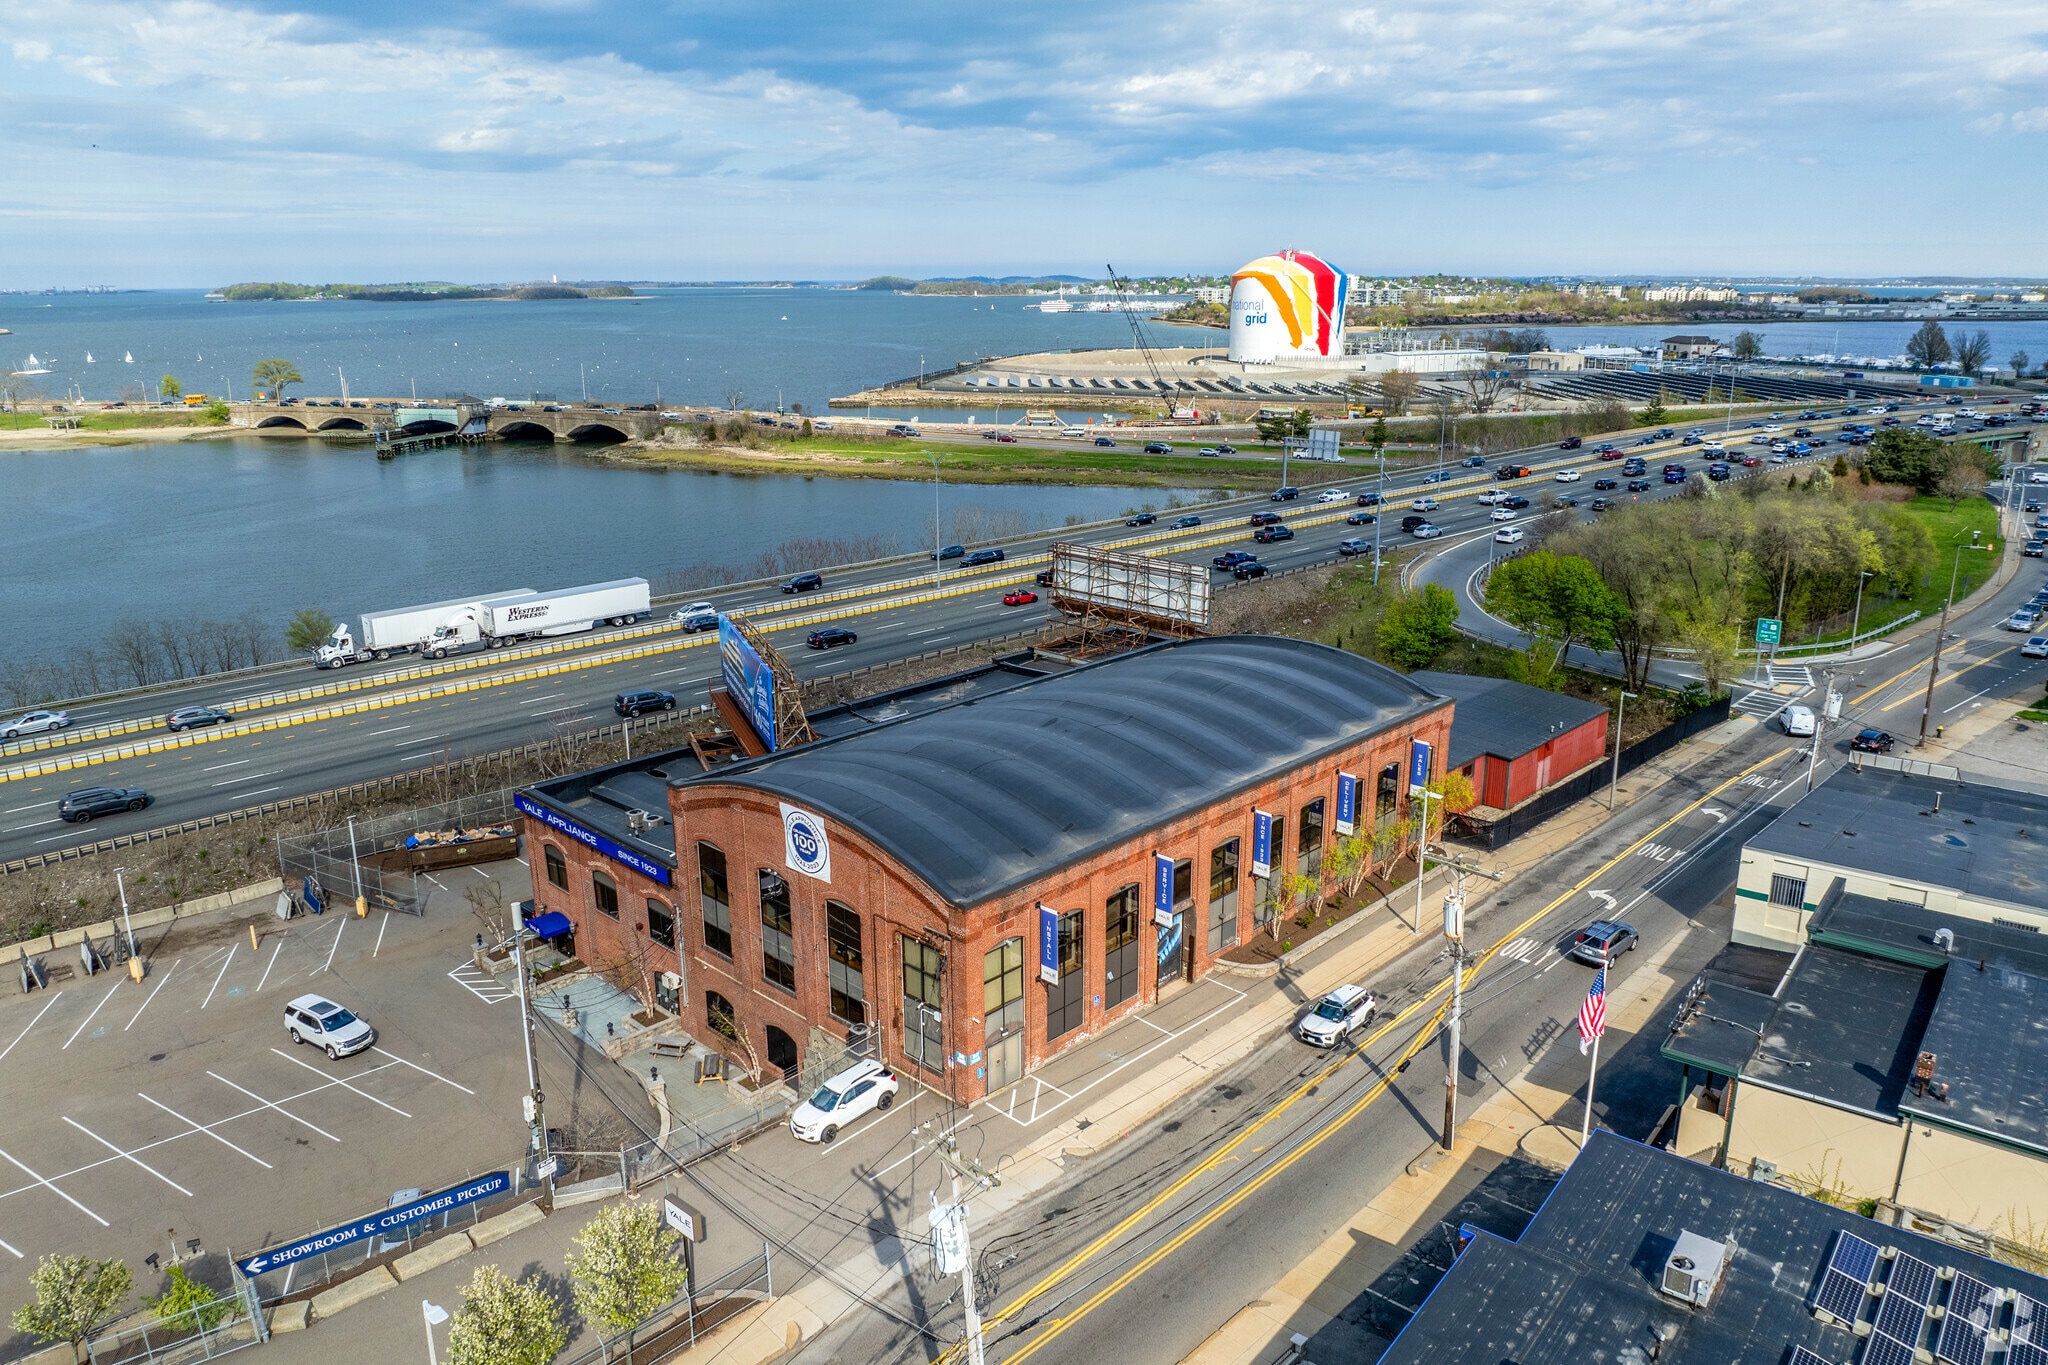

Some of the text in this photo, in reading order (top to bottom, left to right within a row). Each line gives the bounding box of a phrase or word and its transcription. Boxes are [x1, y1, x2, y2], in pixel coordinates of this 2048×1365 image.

[1245, 312, 1267, 326] grid
[1741, 774, 1783, 790] ONLY
[522, 801, 598, 846] YALE APPLIANCE
[793, 833, 816, 852] 100
[1637, 843, 1688, 863] ONLY
[617, 850, 658, 876] SINCE 1923
[1500, 938, 1560, 966] ONLY
[272, 1178, 502, 1265] SHOWROOM & CUSTOMER PICKUP
[668, 1207, 691, 1229] YALE
